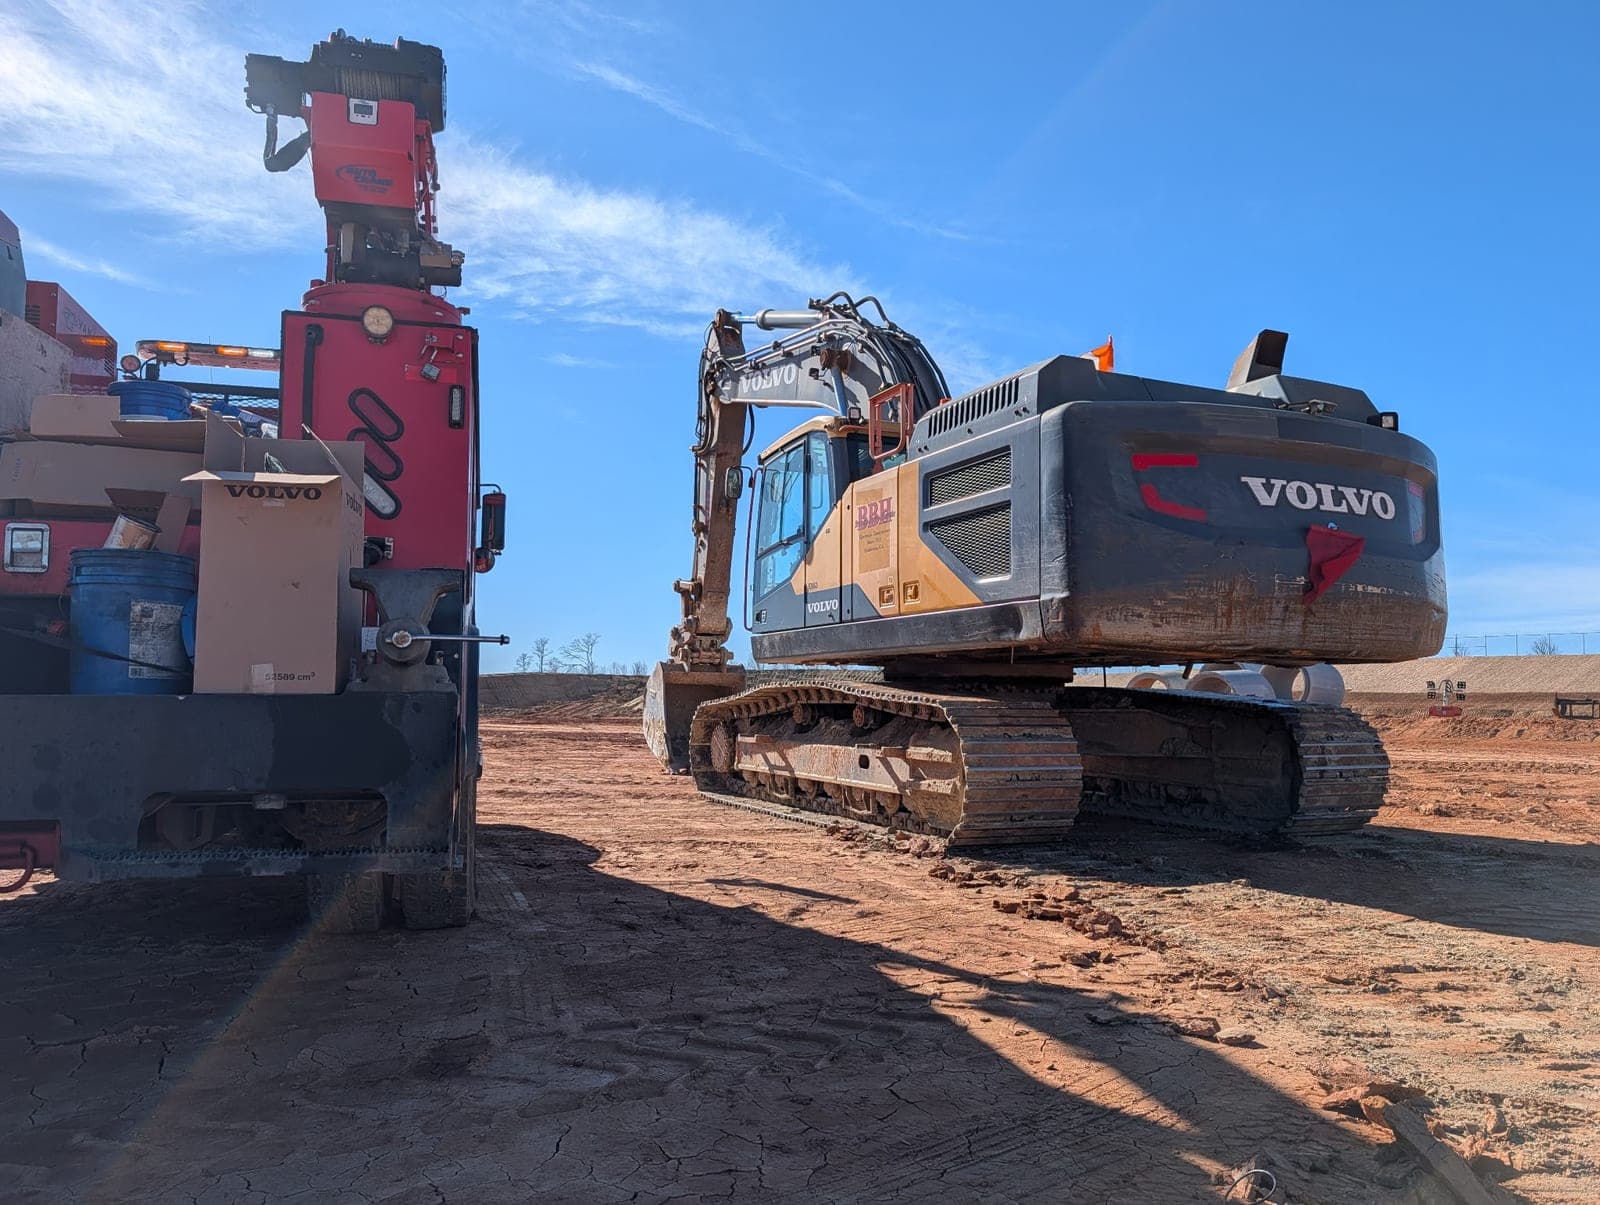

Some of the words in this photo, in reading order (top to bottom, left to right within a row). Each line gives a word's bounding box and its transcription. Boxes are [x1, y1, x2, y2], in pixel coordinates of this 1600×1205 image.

[740, 363, 797, 393] VOLVO
[224, 484, 322, 500] VOLVO
[1241, 476, 1396, 520] VOLVO
[345, 491, 363, 518] VOLVO
[807, 599, 839, 614] VOLVO
[265, 672, 295, 681] 52589
